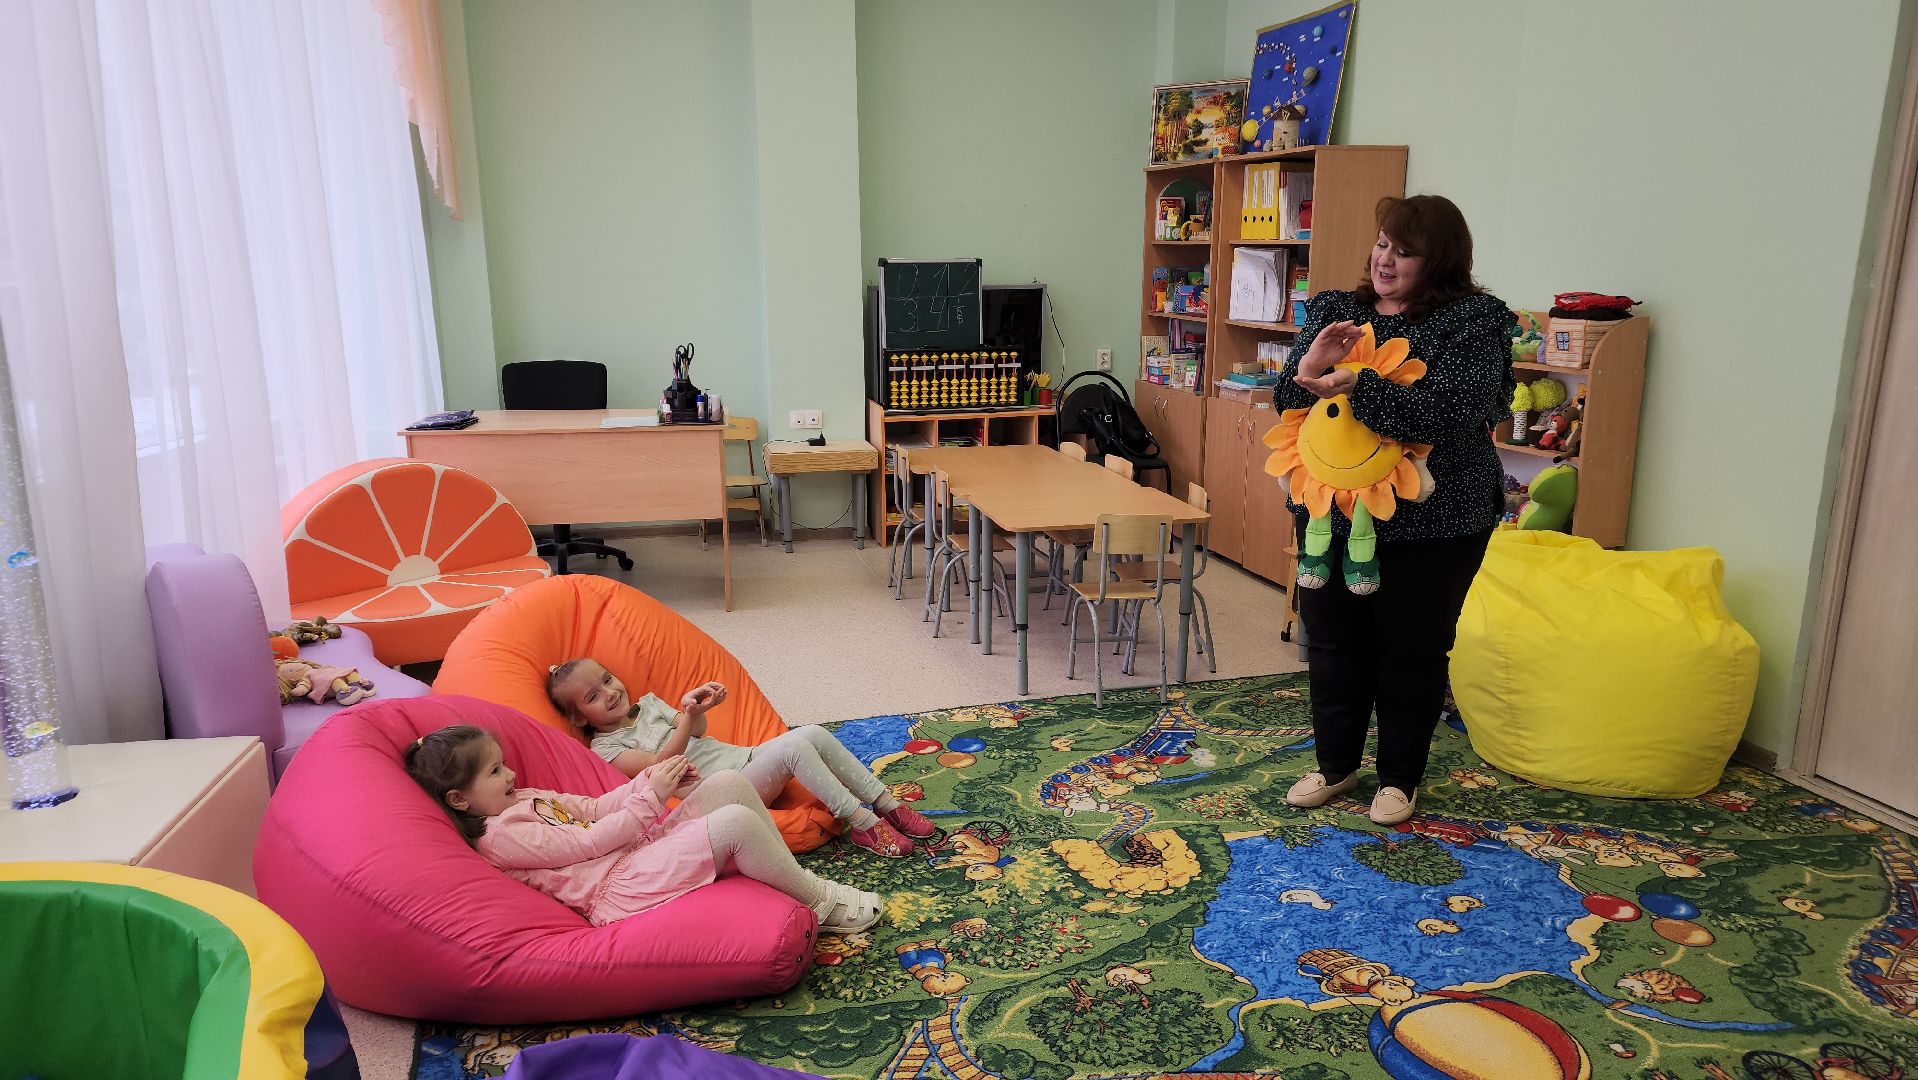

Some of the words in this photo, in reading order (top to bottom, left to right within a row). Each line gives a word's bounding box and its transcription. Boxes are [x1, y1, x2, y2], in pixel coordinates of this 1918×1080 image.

[932, 263, 948, 297] 1
[899, 298, 918, 332] 3
[929, 296, 947, 331] 4
